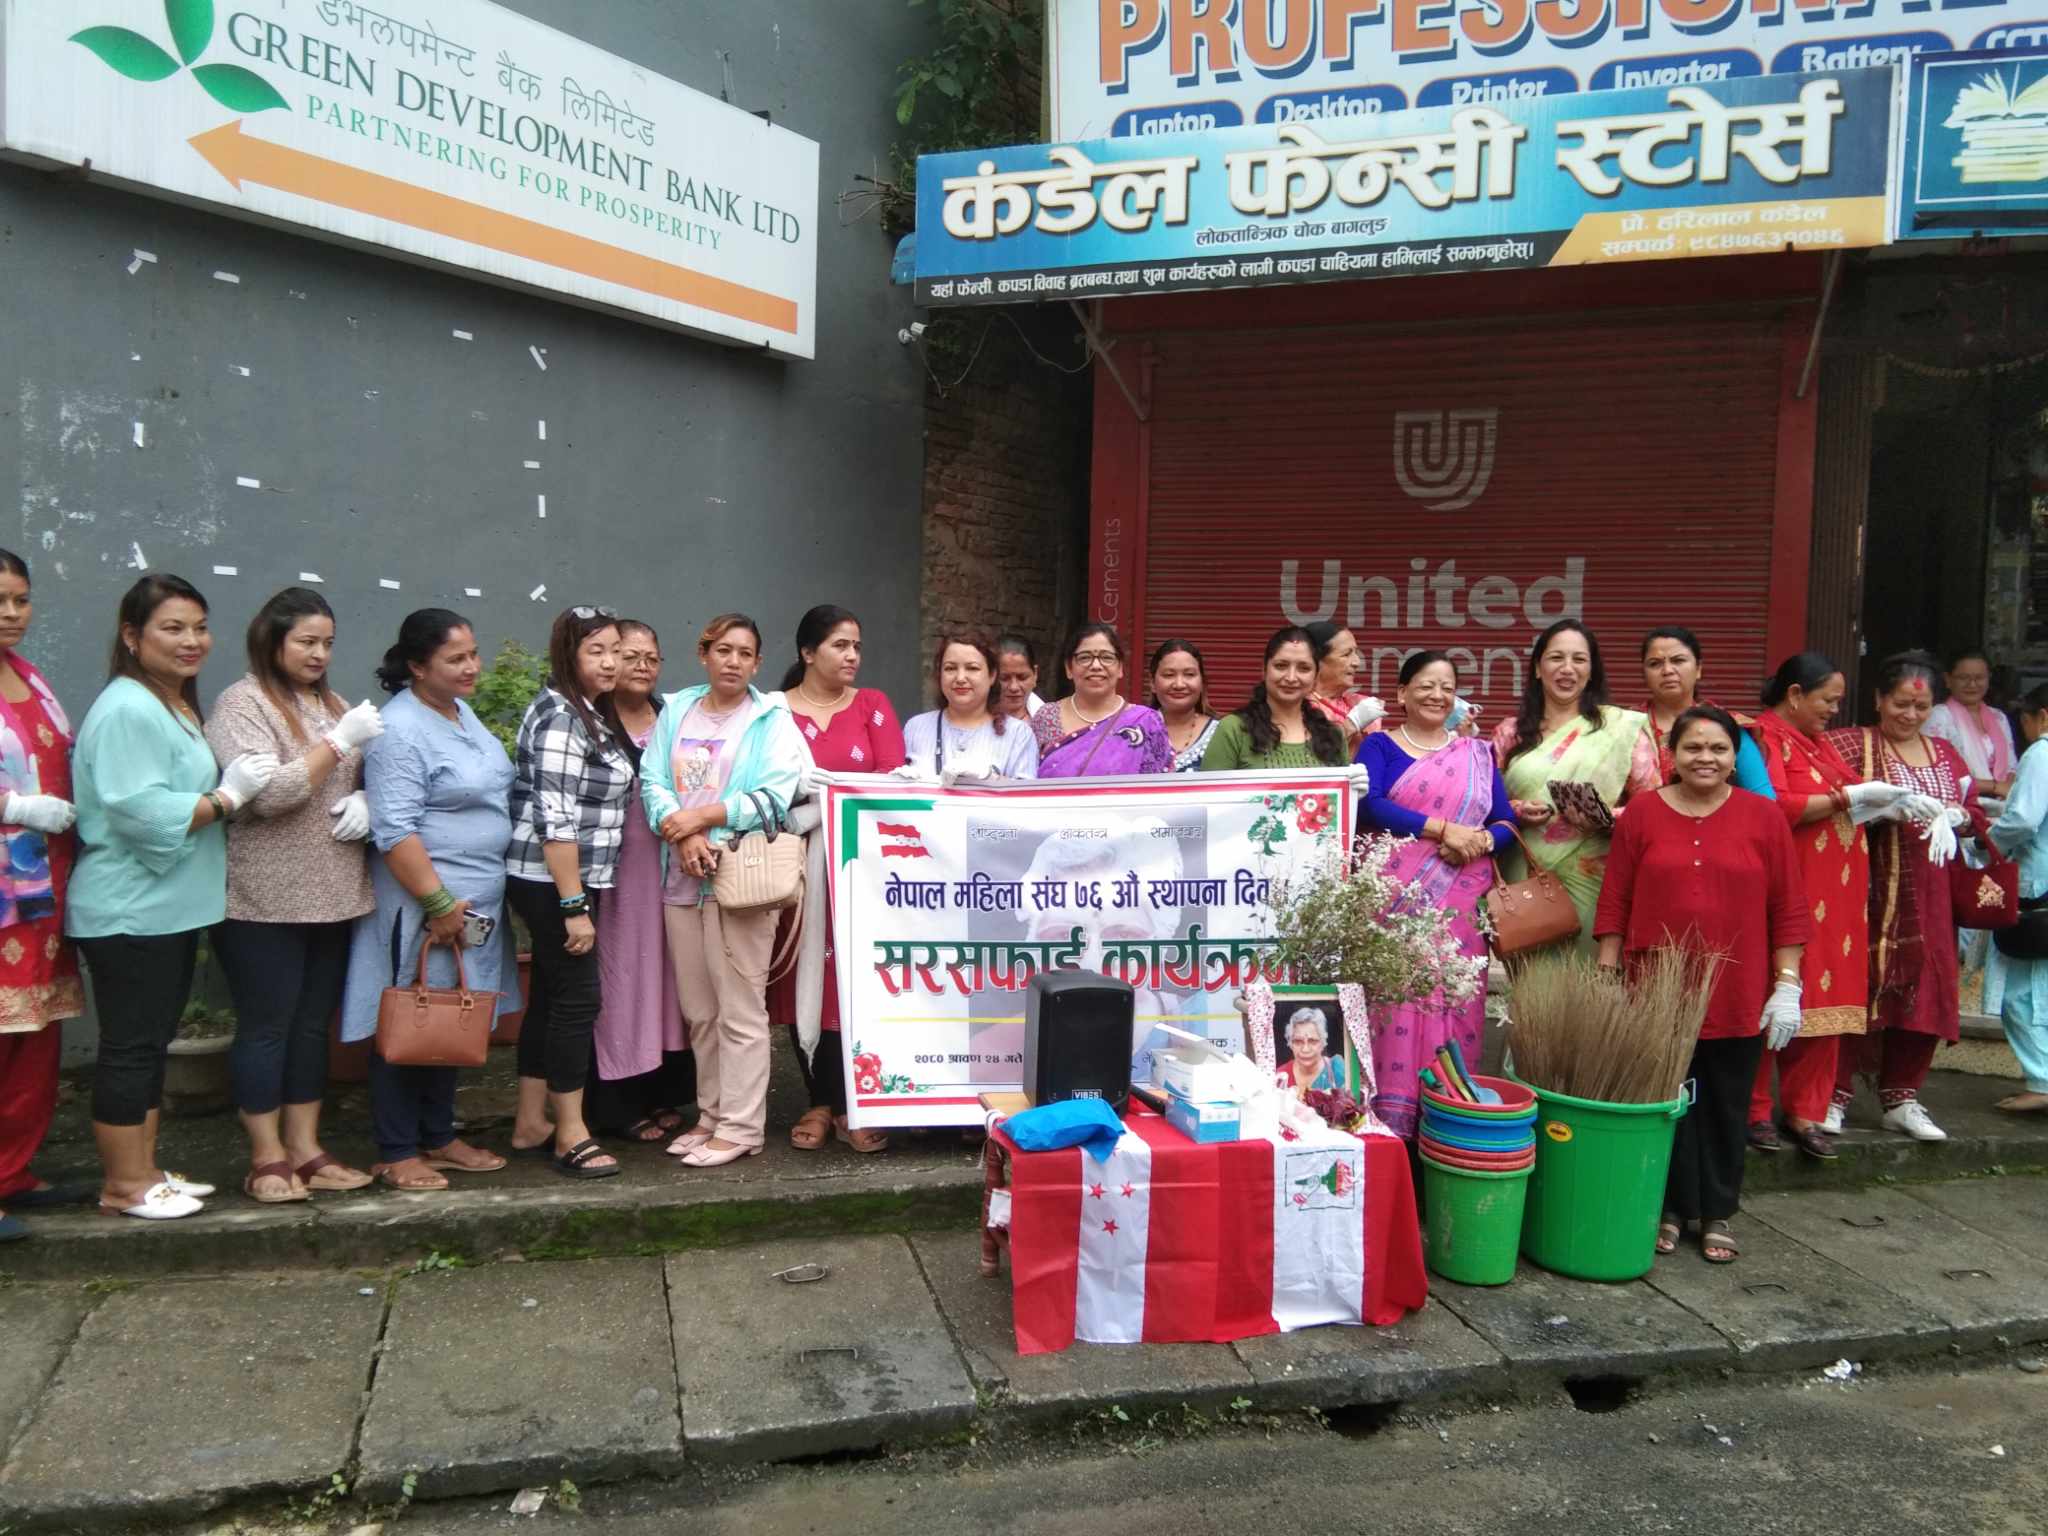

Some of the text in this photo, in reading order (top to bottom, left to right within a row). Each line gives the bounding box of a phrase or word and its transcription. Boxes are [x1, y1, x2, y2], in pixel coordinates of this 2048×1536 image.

[1098, 0, 2006, 96] PROFESS
[227, 12, 801, 245] GREEN DEVELOPMENT BANK LTD
[496, 49, 542, 102] बैंक
[560, 76, 656, 147] लिमिटेड
[1273, 95, 1383, 126] Desktop
[1451, 77, 1548, 105] Printer
[1613, 59, 1731, 91] Inverter
[306, 94, 722, 250] PARTNERING FOR PROSPERITY
[942, 79, 1845, 241] कंडेल फेन्सी स्टोर्स
[1294, 220, 1328, 238] चोक
[1143, 267, 1166, 287] शुभ
[1240, 257, 1274, 277] लागी
[1277, 257, 1316, 274] कपडा
[1098, 517, 1121, 624] Cements
[1280, 557, 1586, 630] United
[885, 872, 946, 909] नेपाल
[954, 872, 1024, 911] महिला
[1031, 875, 1068, 912] संघ
[1074, 880, 1103, 911] ७६
[1147, 879, 1227, 910] स्थापना
[874, 925, 1088, 996] सरसफाई
[1074, 1090, 1100, 1100] VIBES
